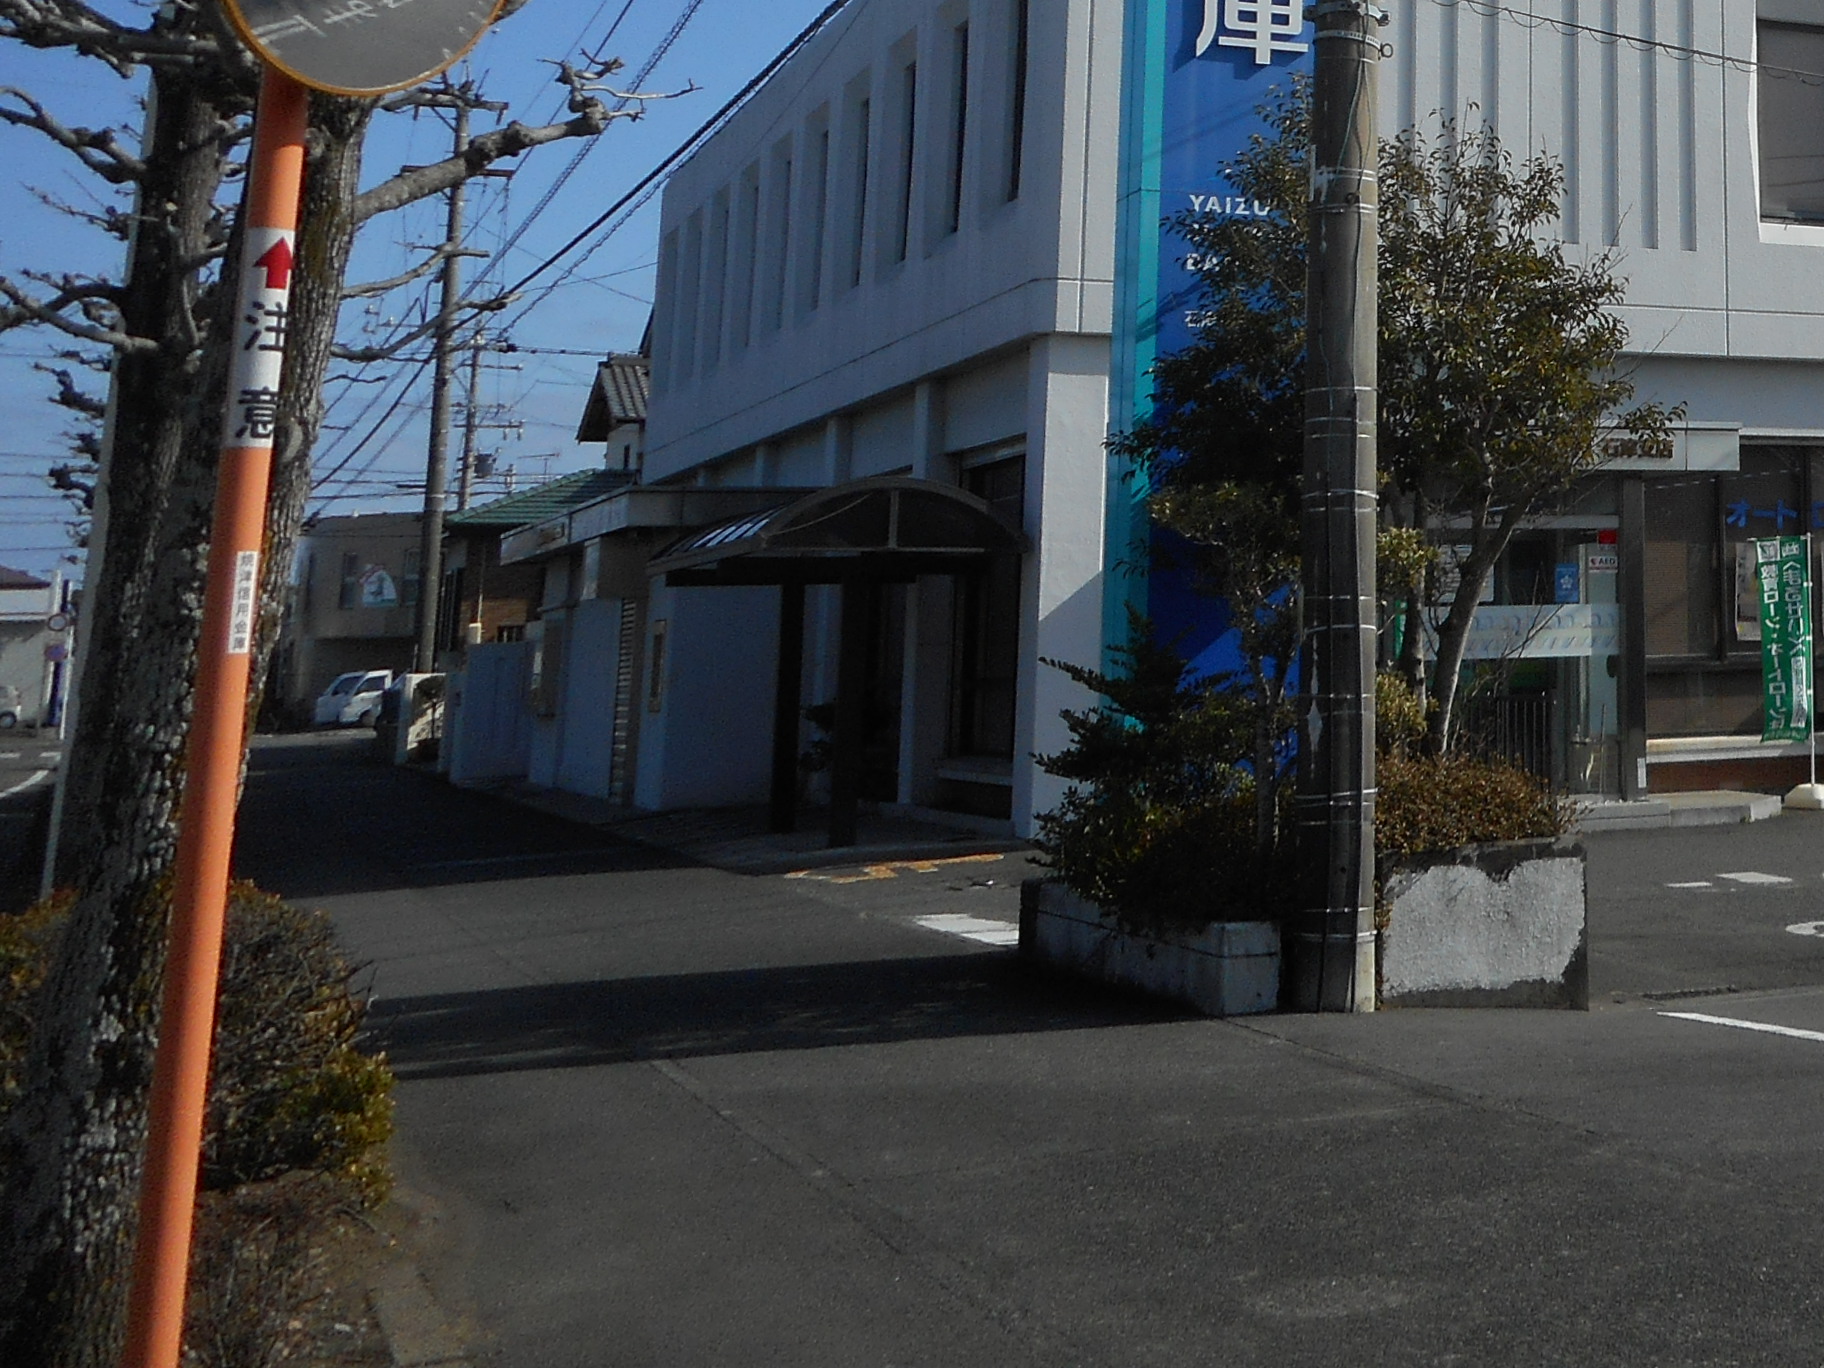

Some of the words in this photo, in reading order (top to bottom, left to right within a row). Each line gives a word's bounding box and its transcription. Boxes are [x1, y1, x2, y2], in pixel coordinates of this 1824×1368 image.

[1189, 194, 1270, 216] YAIZU
[234, 300, 288, 439] 注意
[1598, 556, 1616, 566] AED
